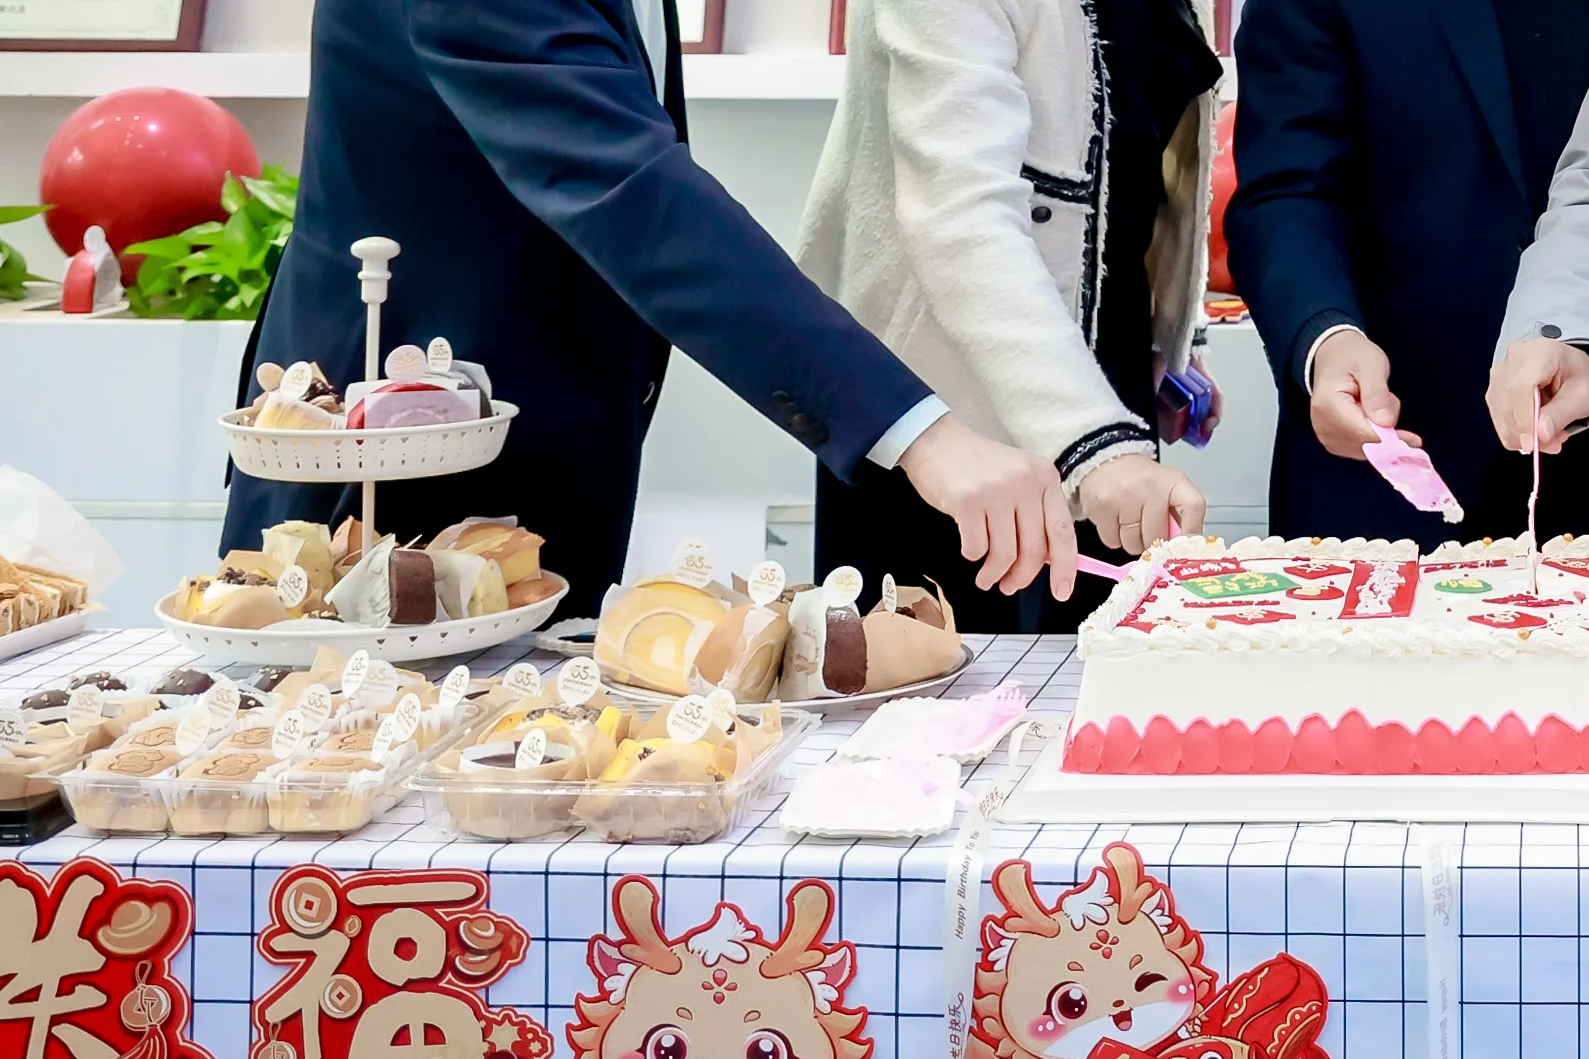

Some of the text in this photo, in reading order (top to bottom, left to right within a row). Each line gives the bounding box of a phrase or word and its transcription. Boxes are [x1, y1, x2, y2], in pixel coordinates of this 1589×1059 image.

[965, 840, 975, 852] To
[957, 854, 973, 900] Birthday
[954, 903, 966, 940] Happy
